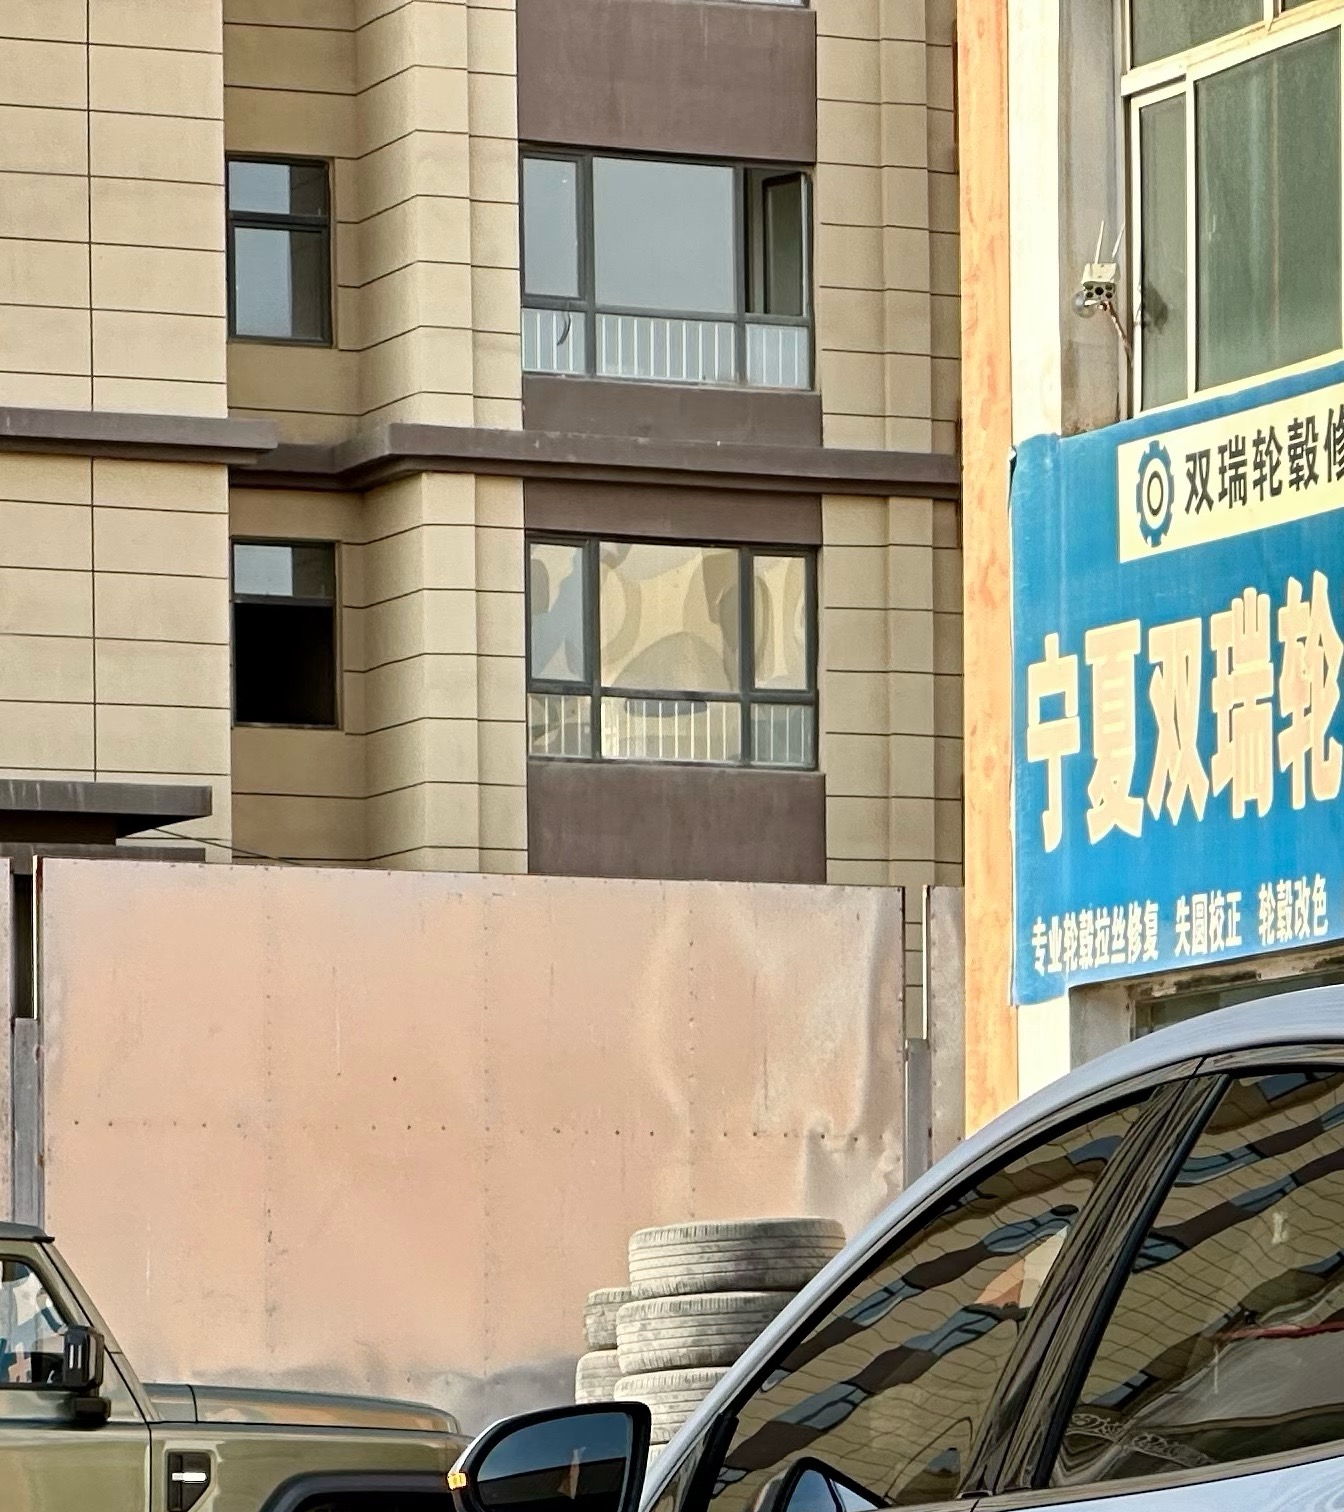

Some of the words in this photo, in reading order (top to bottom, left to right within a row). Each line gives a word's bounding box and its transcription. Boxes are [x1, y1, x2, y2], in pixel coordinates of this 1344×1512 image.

[1031, 899, 1159, 976] 专业轮毂拉丝修复
[1258, 873, 1329, 947] 轮毂改色
